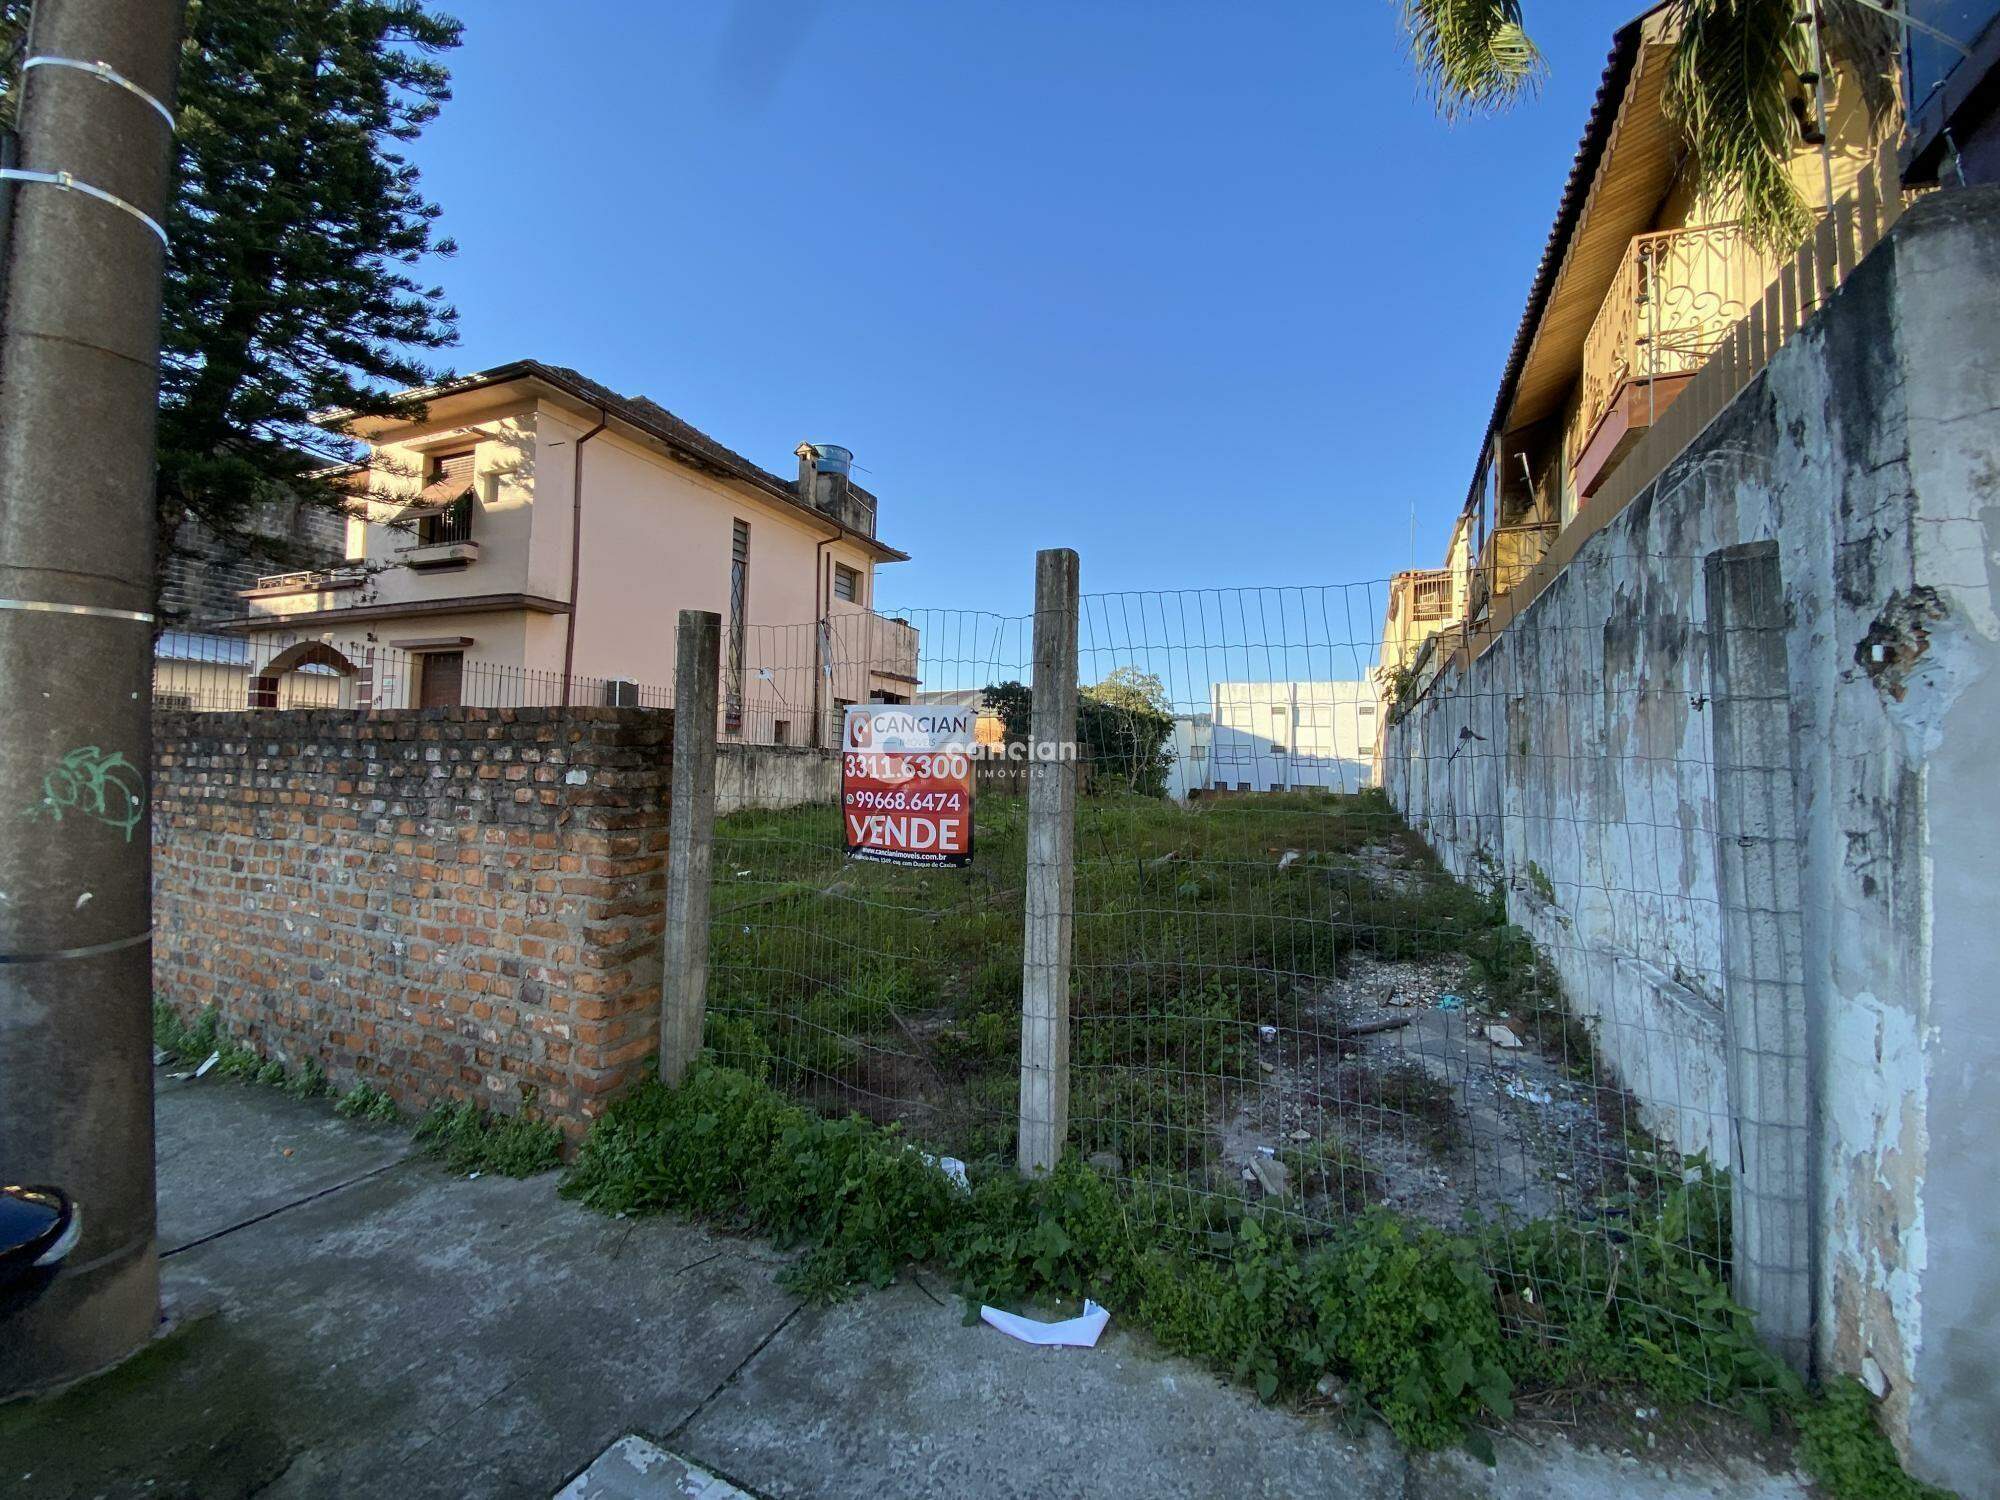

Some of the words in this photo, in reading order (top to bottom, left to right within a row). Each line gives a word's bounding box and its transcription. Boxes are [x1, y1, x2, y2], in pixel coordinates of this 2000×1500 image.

[873, 716, 967, 733] CANCIAN
[845, 754, 968, 780] 3311.6300
[856, 790, 961, 811] 99668.6474
[849, 814, 960, 850] VENDE
